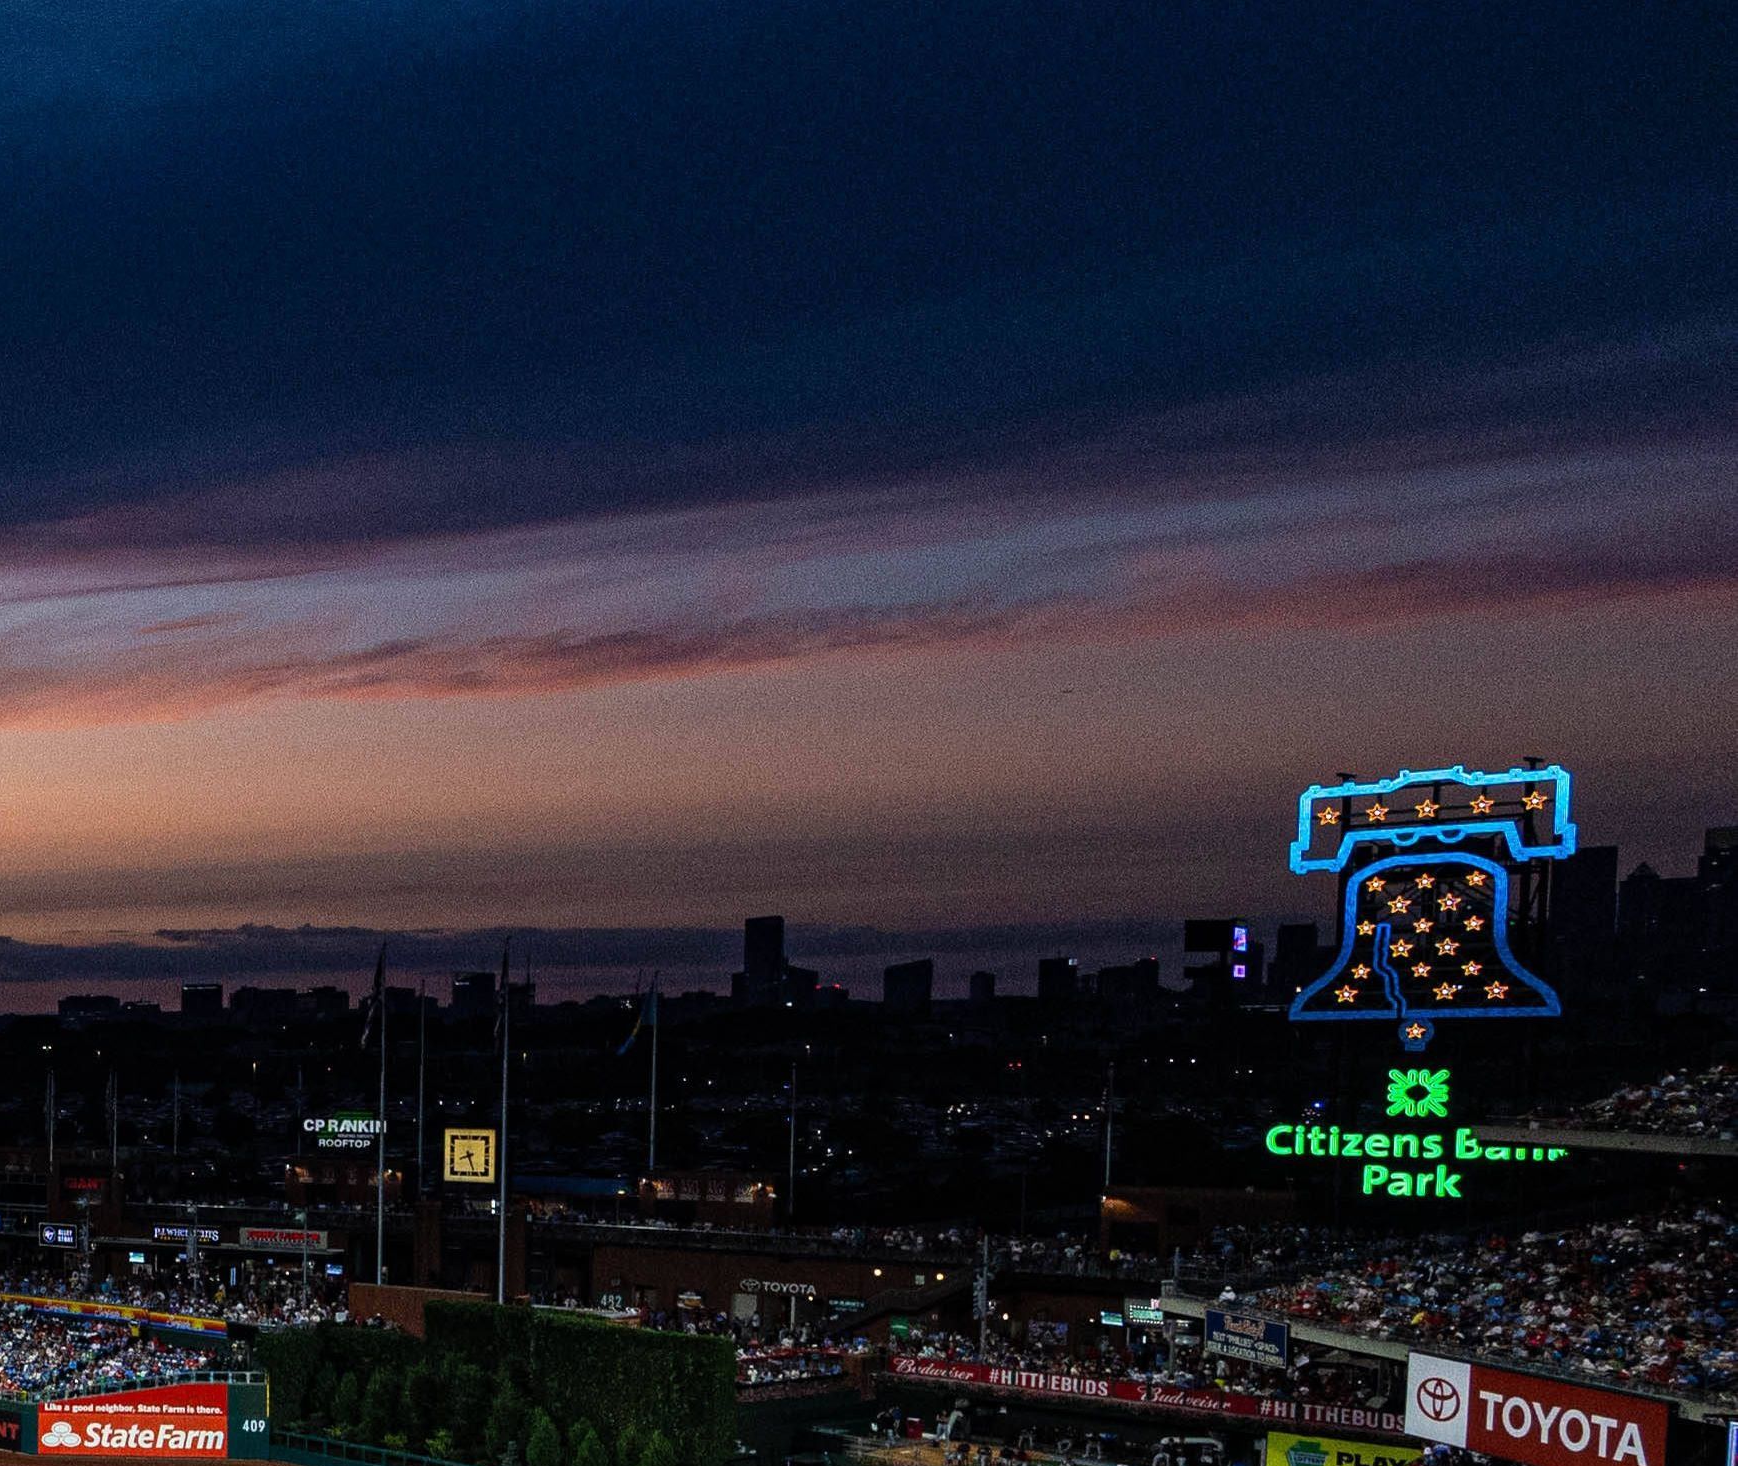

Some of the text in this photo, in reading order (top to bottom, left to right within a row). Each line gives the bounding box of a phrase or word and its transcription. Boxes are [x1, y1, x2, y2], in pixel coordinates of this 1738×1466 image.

[303, 1119, 386, 1133] CP RANKIN
[319, 1138, 371, 1148] ROOFTOP
[1265, 1124, 1442, 1160] Citizens
[1362, 1163, 1462, 1198] Park
[763, 1282, 816, 1295] TOYOTA
[893, 1357, 974, 1381] Budweiser
[44, 1403, 62, 1412] Like
[72, 1404, 93, 1413] good
[95, 1404, 135, 1414] neighbor,
[137, 1404, 160, 1413] State
[162, 1404, 185, 1414] Farm
[187, 1405, 194, 1414] is
[196, 1405, 223, 1414] there.
[242, 1419, 266, 1432] 409
[84, 1422, 224, 1450] State Farm
